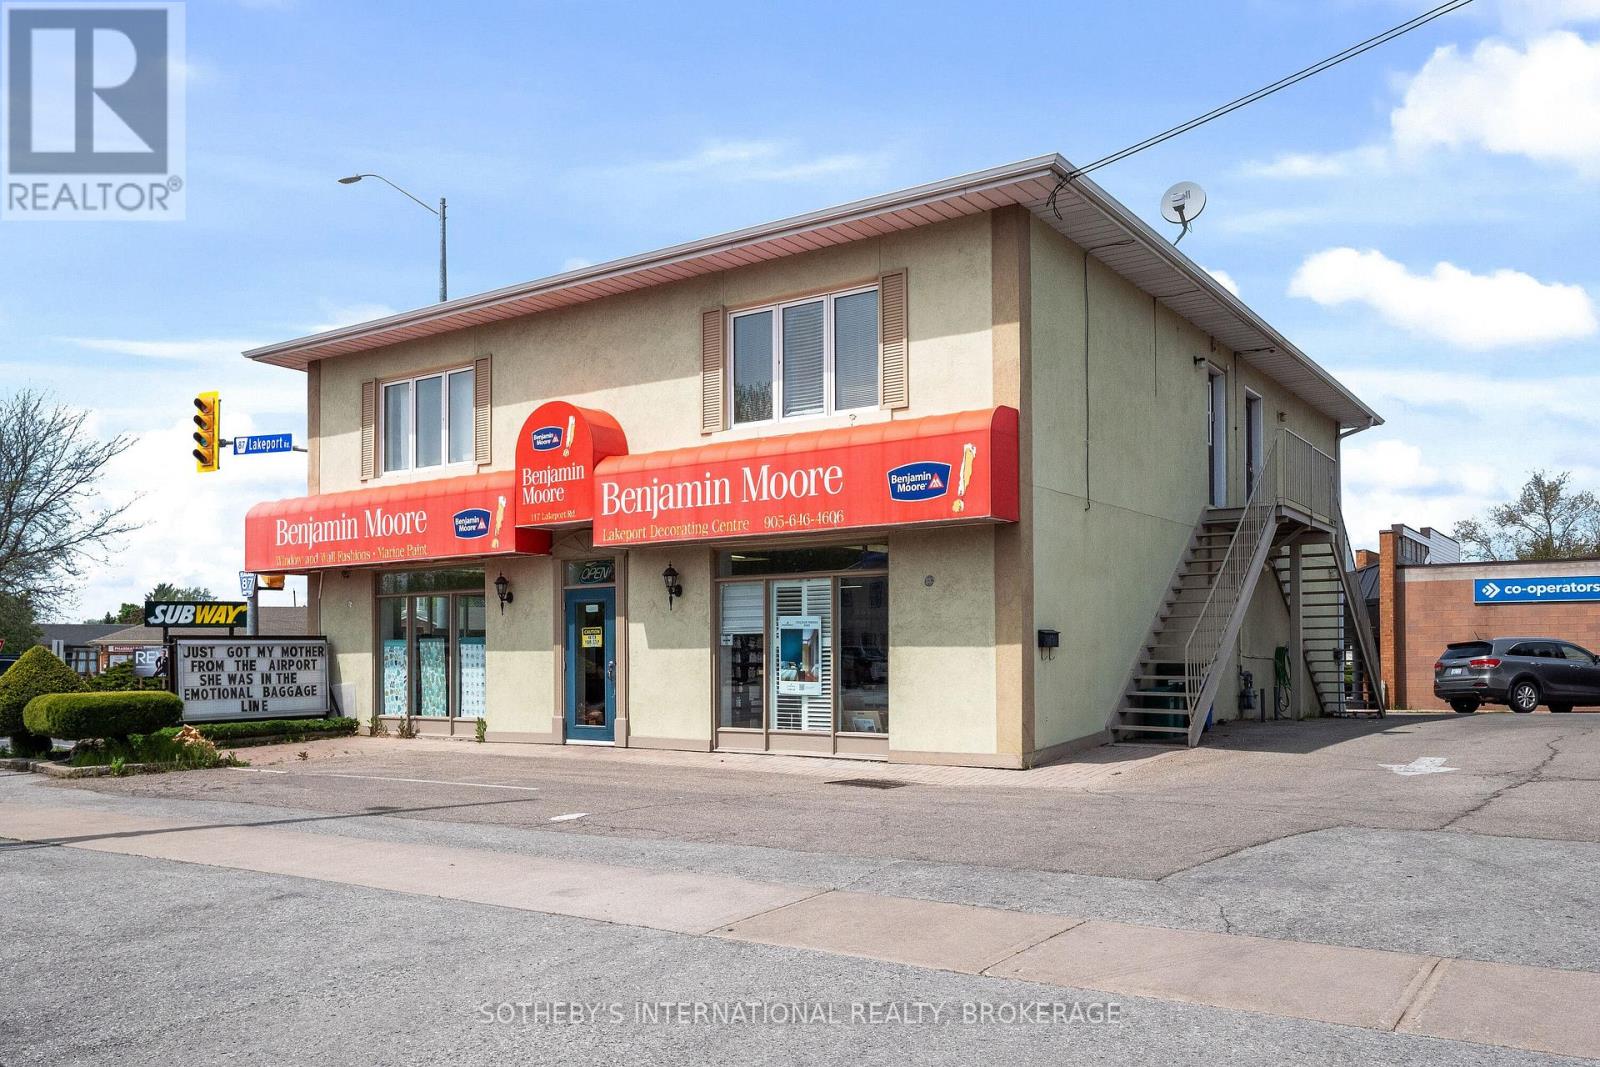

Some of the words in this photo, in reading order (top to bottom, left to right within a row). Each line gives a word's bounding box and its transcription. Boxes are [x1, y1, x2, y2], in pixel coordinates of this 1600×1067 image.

[237, 440, 246, 450] 87
[248, 437, 283, 452] Lakeport
[522, 461, 585, 487] Benjamin
[891, 470, 931, 485] Benjamin
[601, 471, 731, 520] Benjamin
[741, 464, 844, 503] Moore
[897, 481, 926, 493] Moore
[522, 486, 565, 505] Moore
[455, 515, 480, 526] Benjamin
[541, 511, 567, 520] Lakeport
[275, 513, 359, 549] Benjamin
[364, 508, 427, 538] Moore
[459, 524, 477, 532] Moore
[602, 527, 647, 543] Lakeport
[650, 522, 709, 538] Decorating
[711, 517, 751, 533] Centre
[763, 510, 845, 529] 905-646-4606
[275, 554, 302, 567] Window
[304, 552, 319, 564] and
[337, 549, 371, 562] Fashions
[406, 544, 428, 556] Paint
[581, 567, 610, 580] OPEN
[242, 578, 254, 590] 87
[1504, 582, 1600, 597] co-operators
[148, 604, 247, 625] SUBWAY
[183, 646, 215, 659] JUST
[227, 646, 251, 657] GOT
[257, 646, 274, 658] MY
[281, 645, 325, 657] MOTHER
[191, 660, 224, 672] FROM
[235, 660, 256, 671] THE
[269, 659, 317, 671] AIRPORT
[200, 674, 222, 686] SHE
[228, 673, 253, 686] WAS
[261, 673, 272, 685] IN
[276, 672, 297, 684] THE
[184, 687, 253, 700] EMOTIONAL
[263, 685, 317, 697] BAGGAGE
[241, 700, 269, 712] LINE
